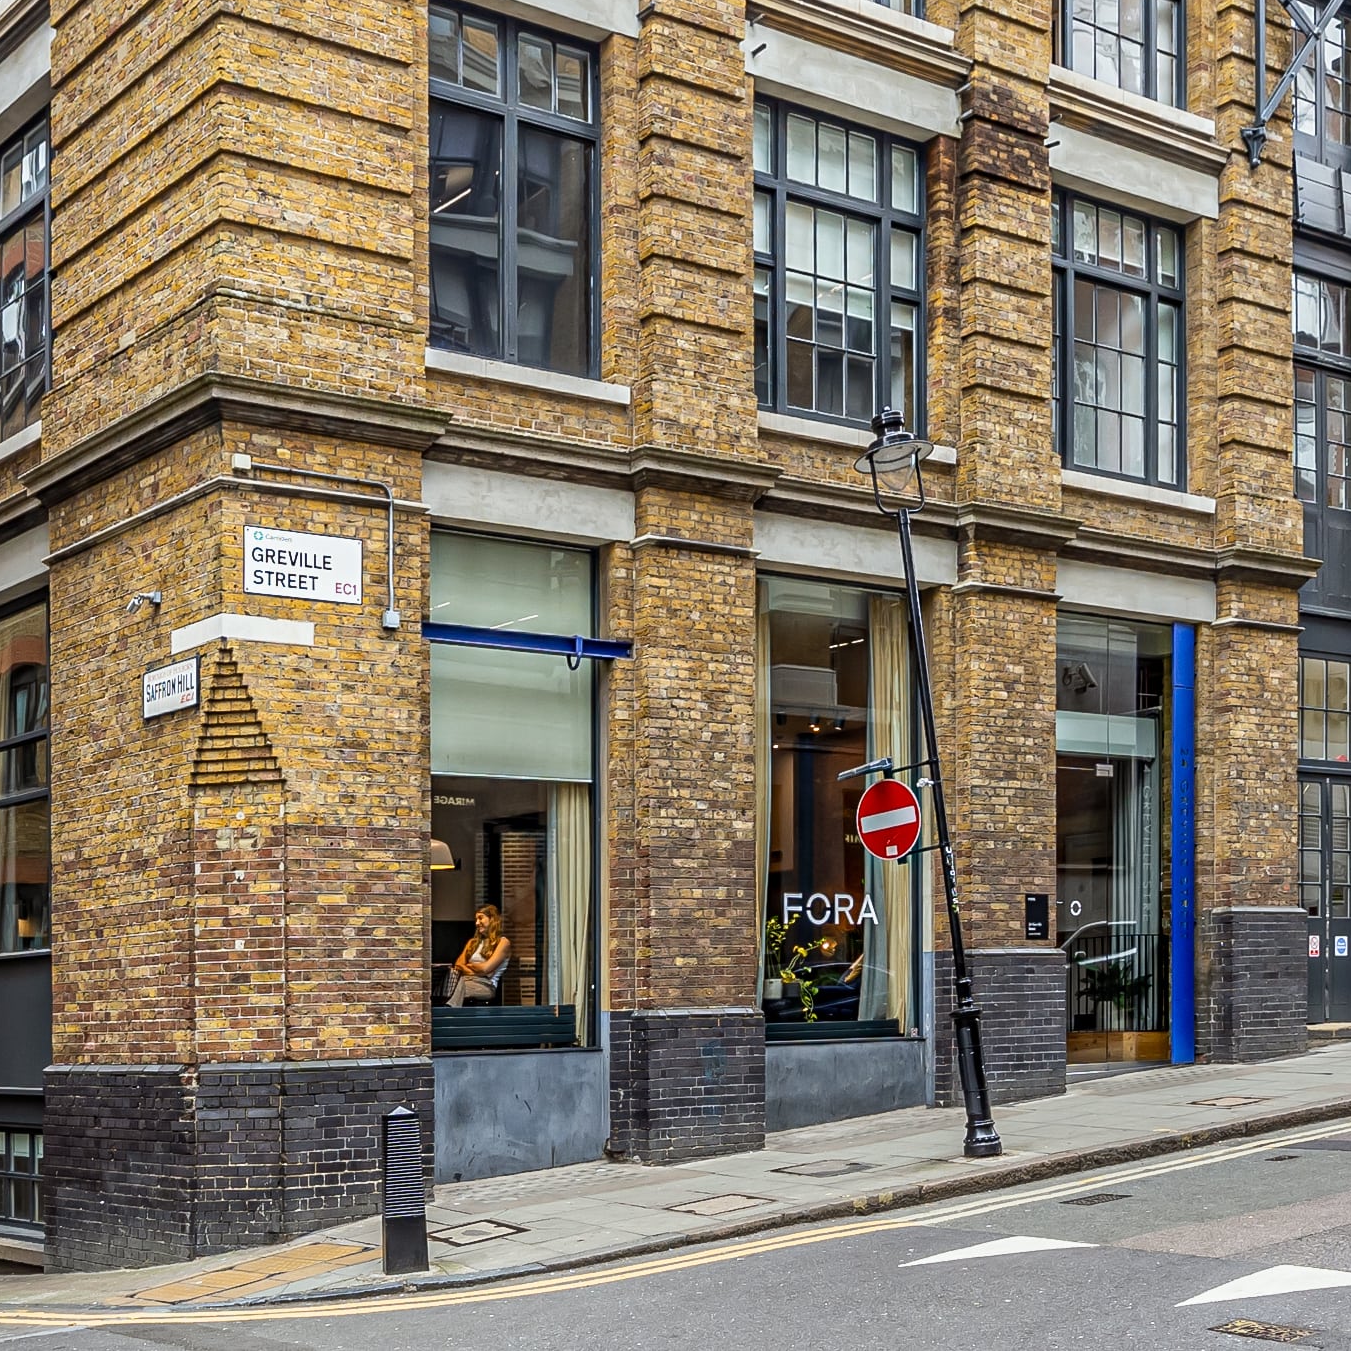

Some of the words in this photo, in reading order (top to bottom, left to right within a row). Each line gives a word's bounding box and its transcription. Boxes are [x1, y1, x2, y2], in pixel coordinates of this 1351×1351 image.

[251, 547, 332, 570] GREVILLE
[253, 569, 318, 591] STREET
[335, 582, 357, 596] EC1
[146, 679, 176, 703] SAFFRON
[177, 672, 194, 694] HILL
[180, 691, 195, 704] EC1
[1180, 778, 1190, 867] GREVILLE
[783, 892, 879, 925] FORA
